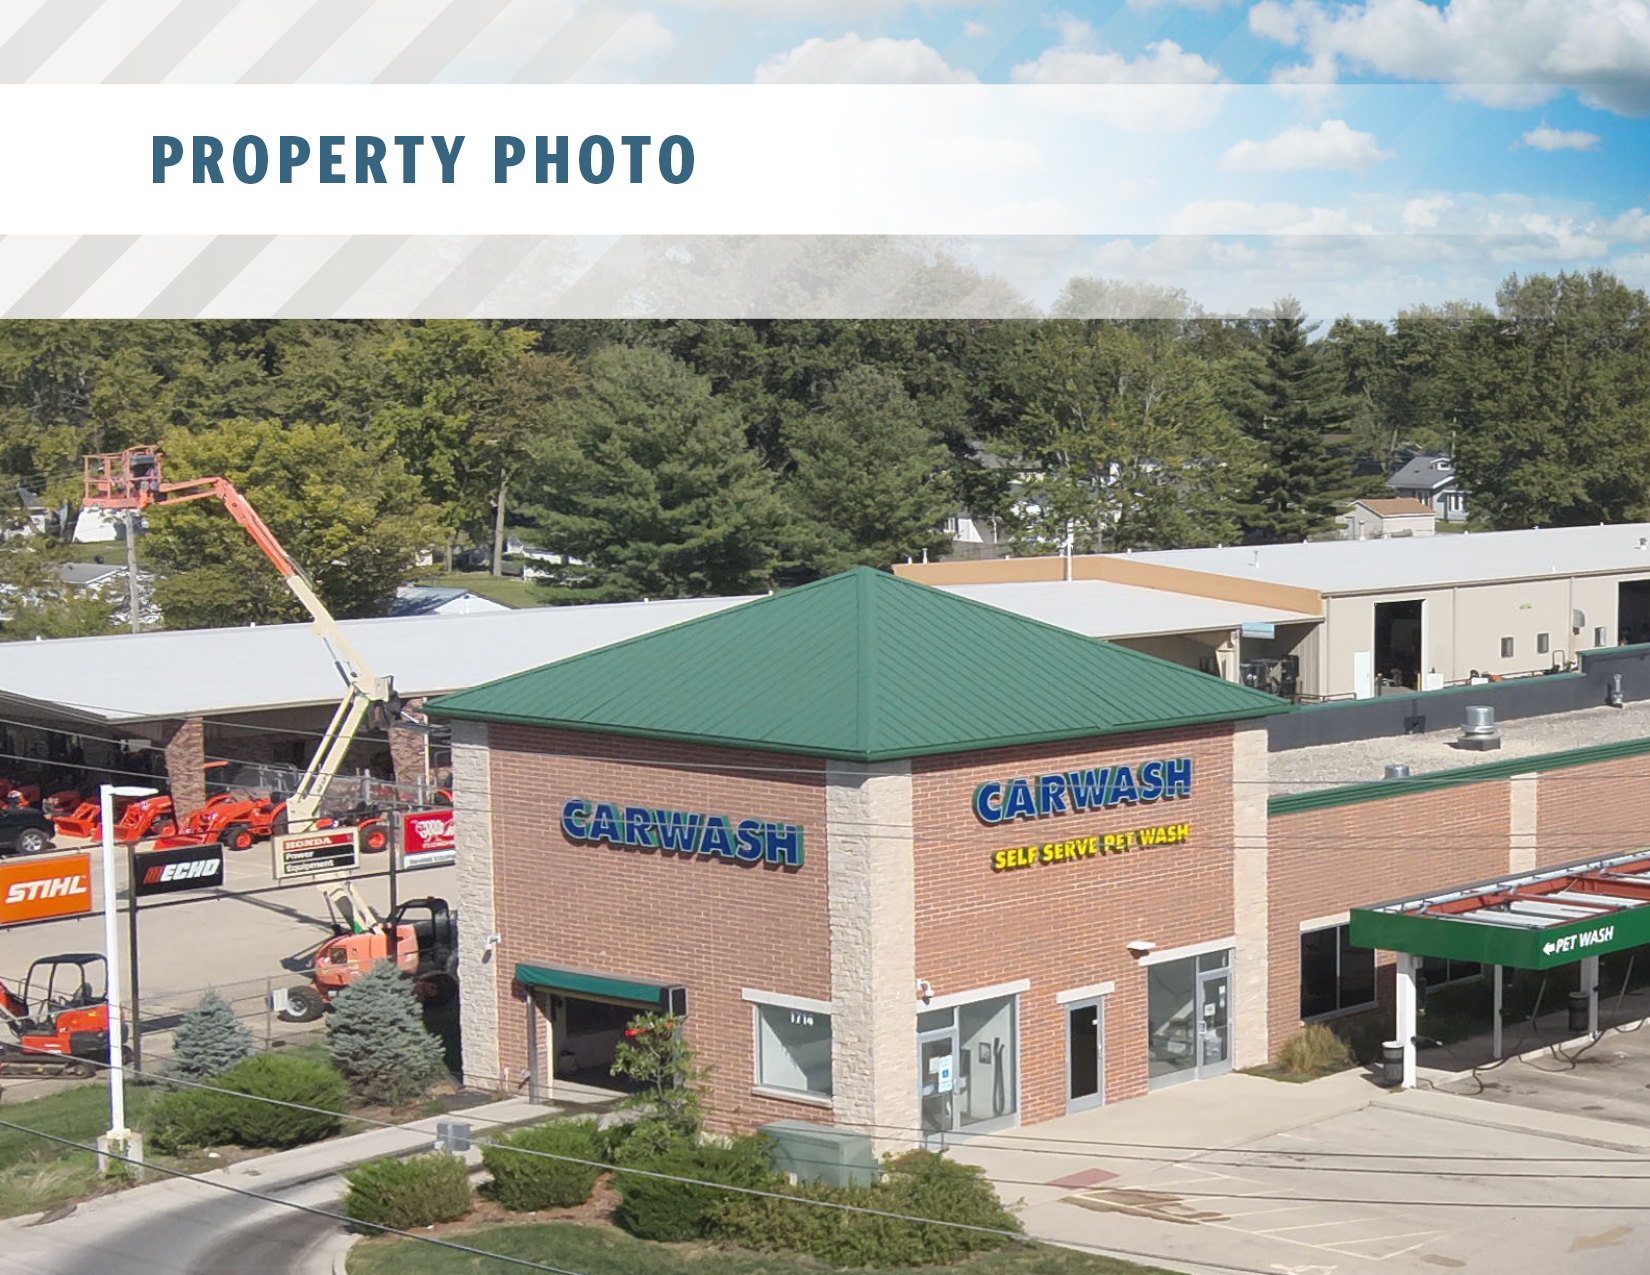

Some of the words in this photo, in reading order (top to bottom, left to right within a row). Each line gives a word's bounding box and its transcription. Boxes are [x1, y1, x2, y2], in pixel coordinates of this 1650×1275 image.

[973, 757, 1192, 824] CARWASH
[285, 837, 333, 849] HONDA
[561, 798, 804, 866] CARWASH
[993, 846, 1037, 870] SELF
[1041, 836, 1098, 862] SERVE
[1103, 831, 1135, 852] PET
[1138, 823, 1190, 846] WASH
[160, 858, 221, 882] ECHO
[285, 851, 315, 861] Power
[286, 859, 334, 873] Equipment
[6, 875, 87, 904] STIHL
[1555, 934, 1578, 954] PET
[1579, 925, 1615, 948] WASH
